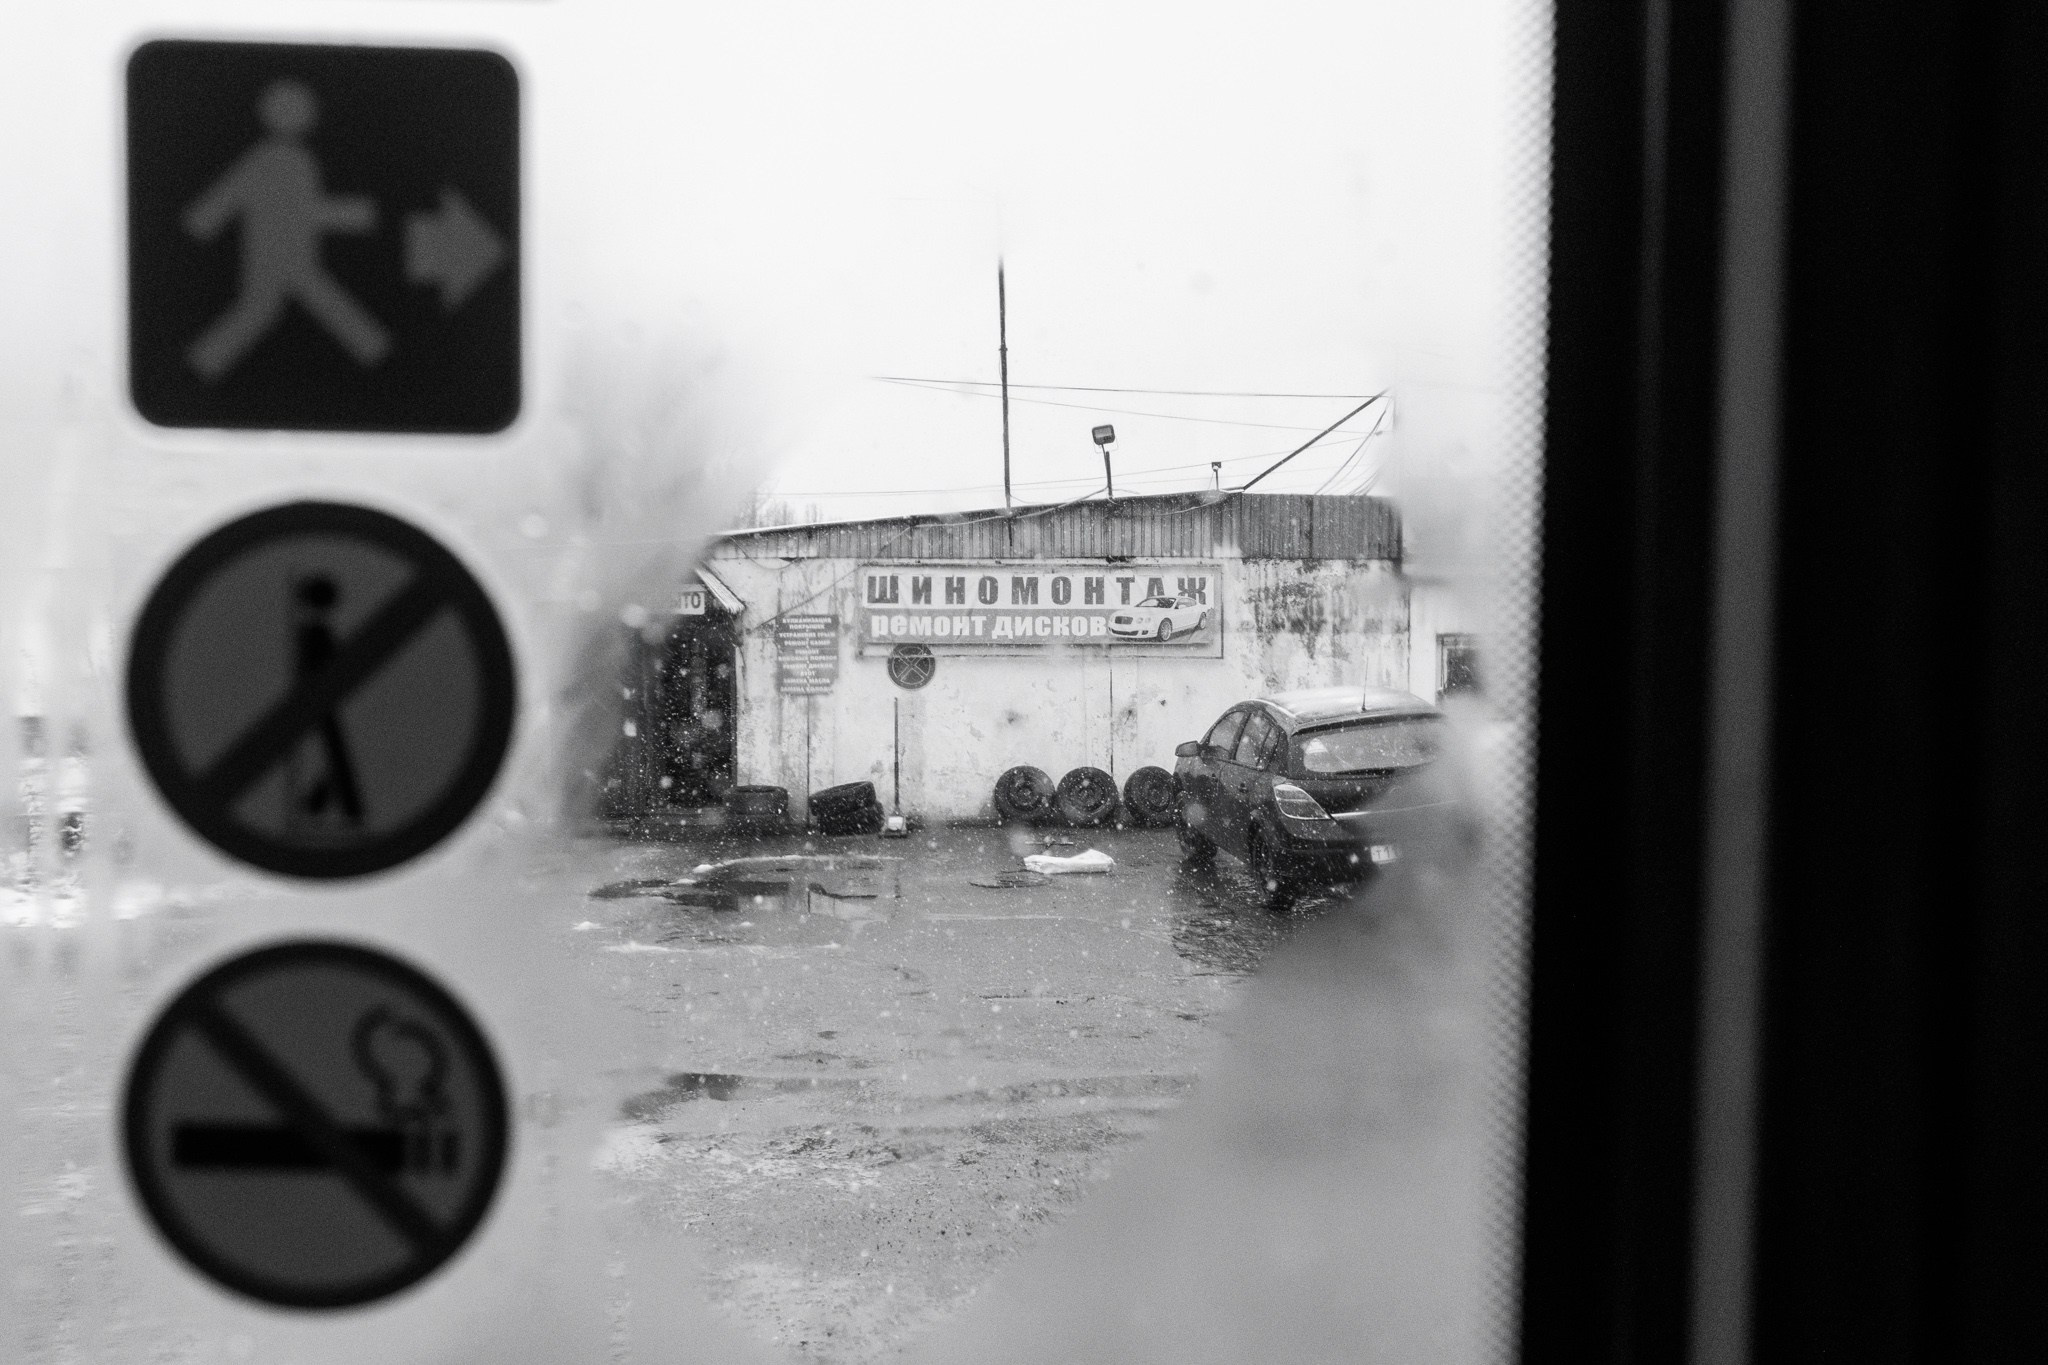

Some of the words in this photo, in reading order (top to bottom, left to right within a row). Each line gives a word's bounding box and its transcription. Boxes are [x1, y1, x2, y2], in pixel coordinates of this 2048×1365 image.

[867, 575, 1207, 605] ШИНОМОНТАЖ
[871, 614, 987, 637] ремонт
[991, 615, 1107, 639] дисков
